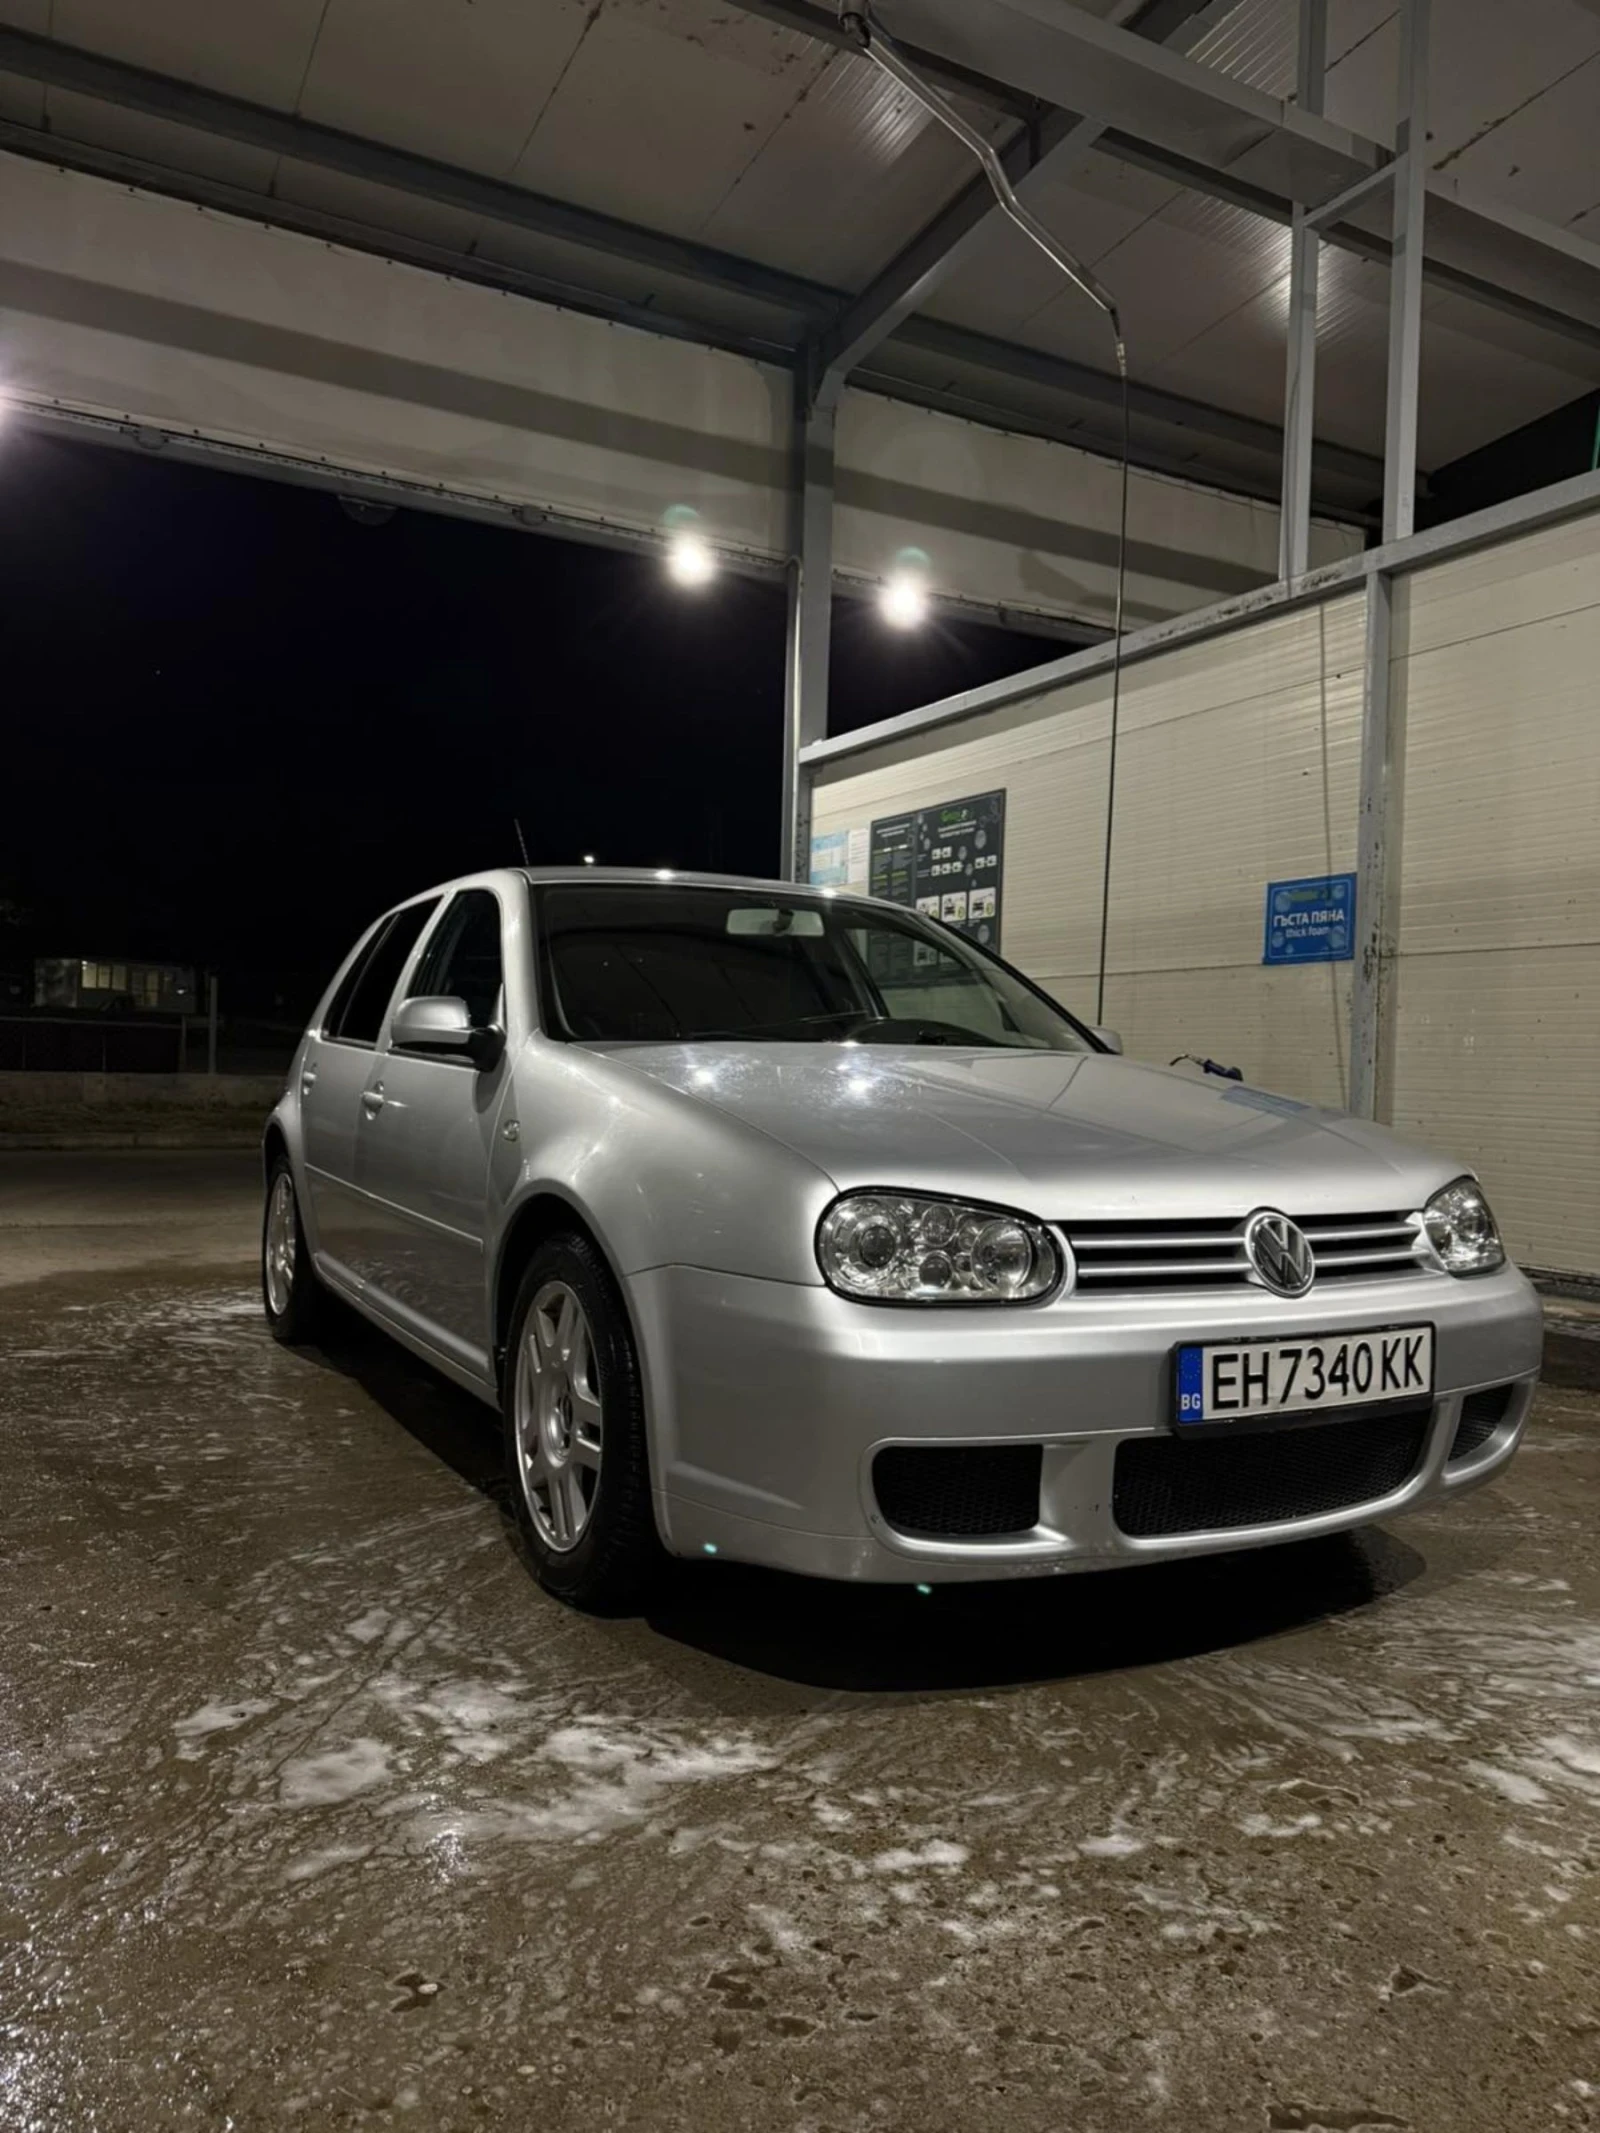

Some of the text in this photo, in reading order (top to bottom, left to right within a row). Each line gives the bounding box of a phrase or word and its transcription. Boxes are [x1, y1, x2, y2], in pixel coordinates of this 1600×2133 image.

[1311, 909, 1344, 923] ПЯНА
[1286, 926, 1330, 937] thick foam
[1181, 1393, 1201, 1410] BG
